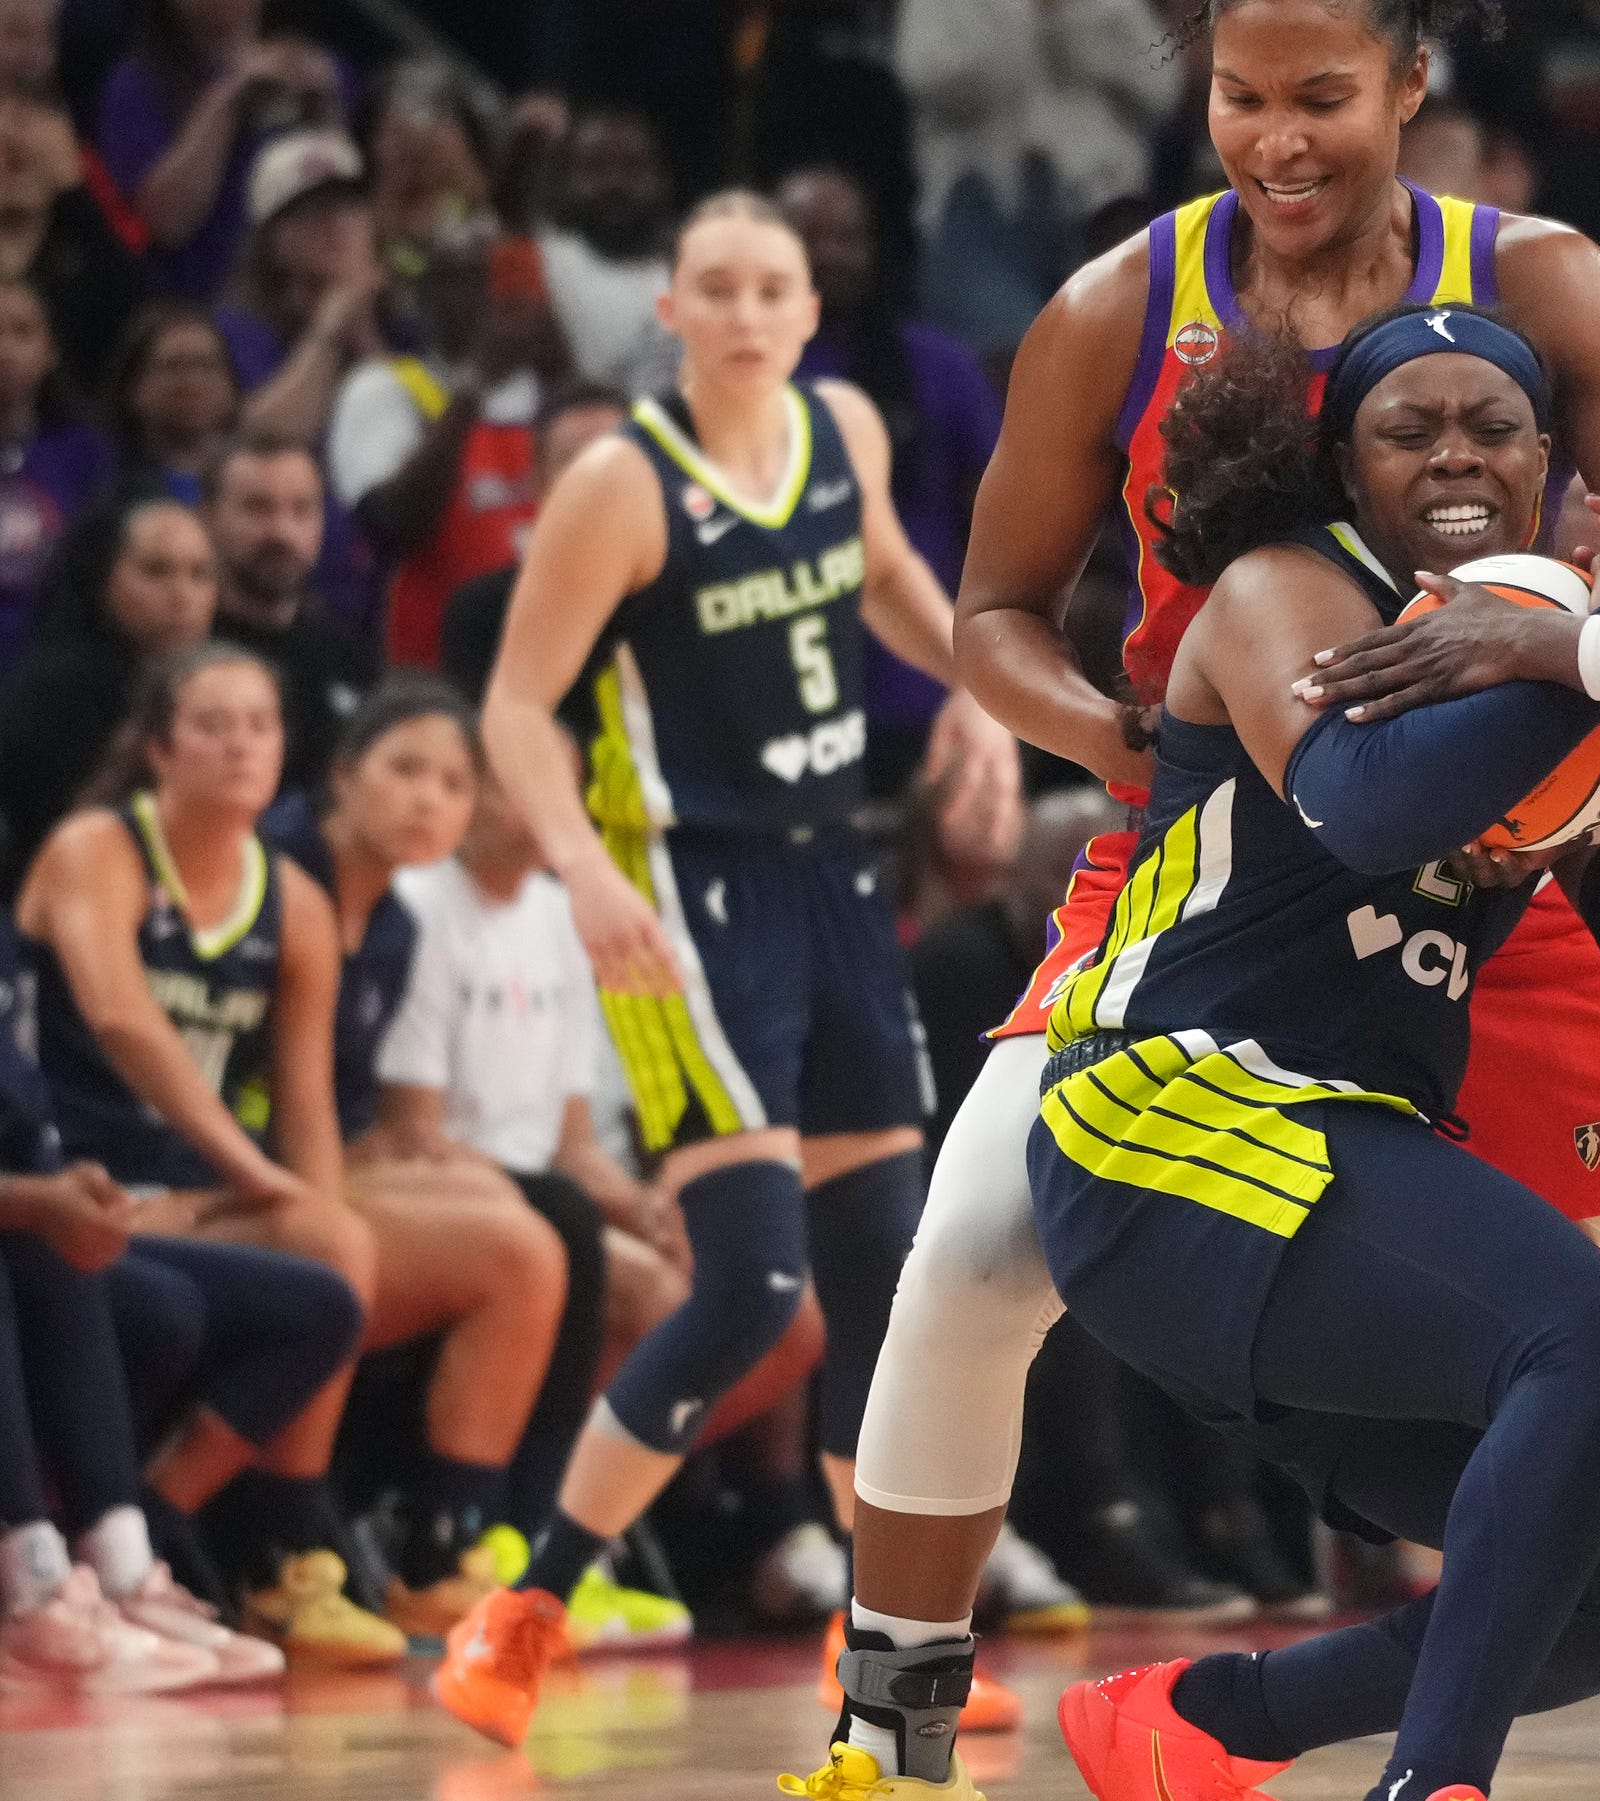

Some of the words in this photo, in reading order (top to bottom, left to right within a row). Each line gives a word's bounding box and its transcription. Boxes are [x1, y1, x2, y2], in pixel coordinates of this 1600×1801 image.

[790, 614, 838, 713] 5
[808, 708, 867, 775] CV
[1402, 929, 1469, 1002] CV
